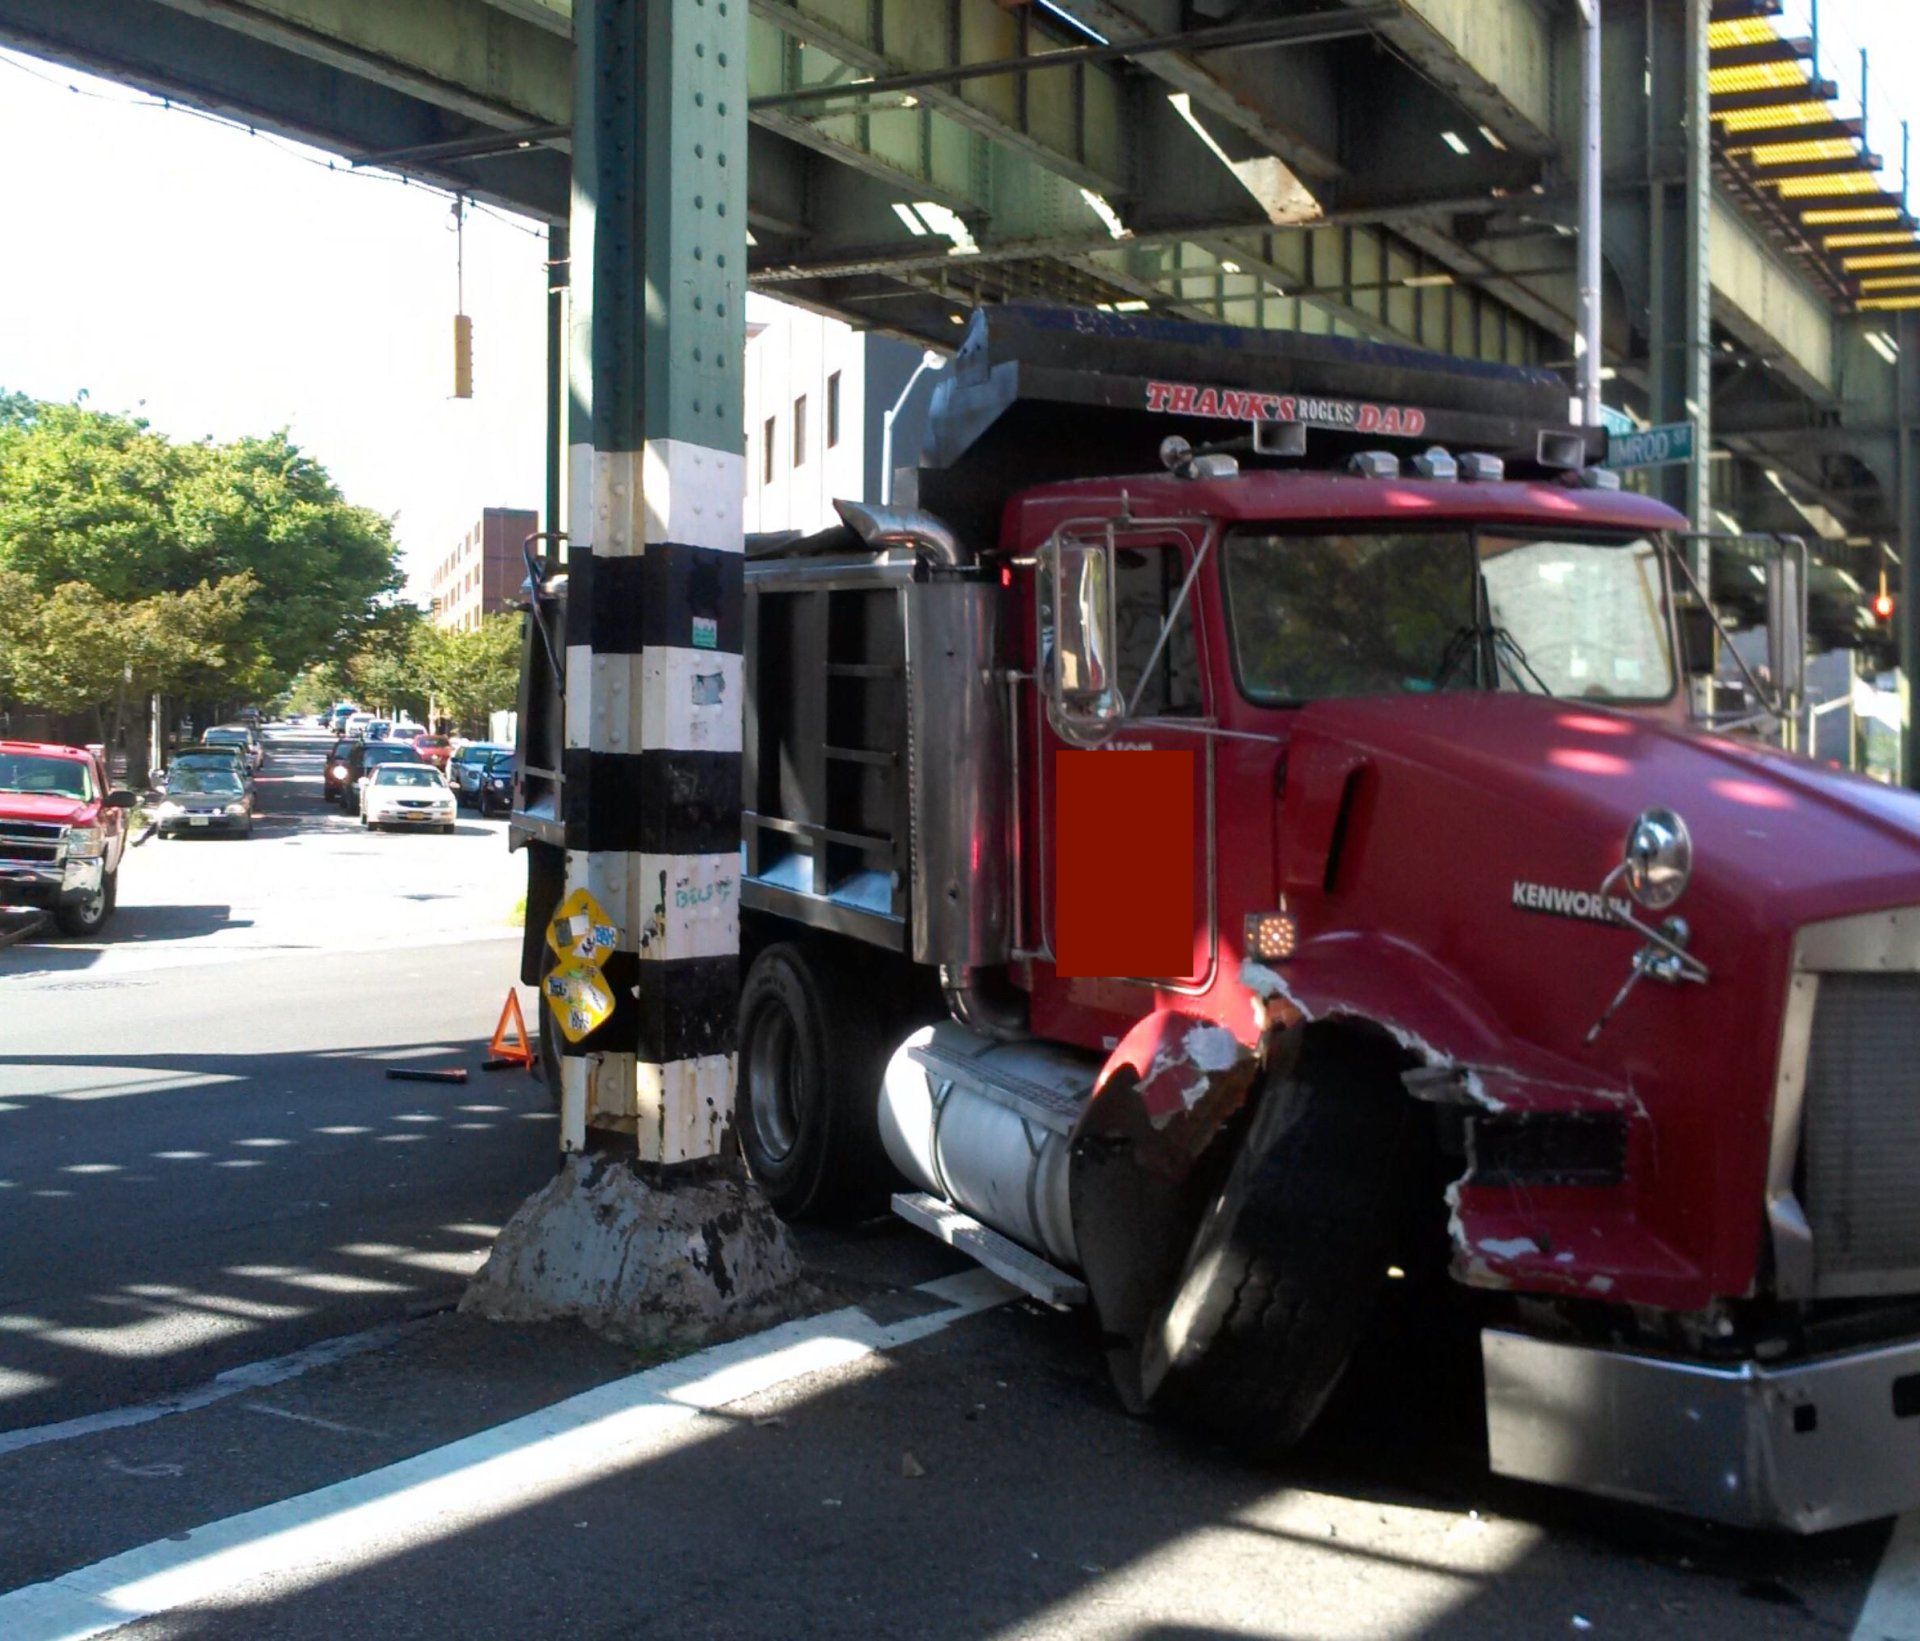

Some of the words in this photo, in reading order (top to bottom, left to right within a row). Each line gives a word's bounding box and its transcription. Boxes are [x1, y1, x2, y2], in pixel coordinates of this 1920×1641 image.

[1146, 382, 1296, 421] THANK'S
[1299, 399, 1354, 423] ROGERS
[1355, 404, 1425, 437] DAD
